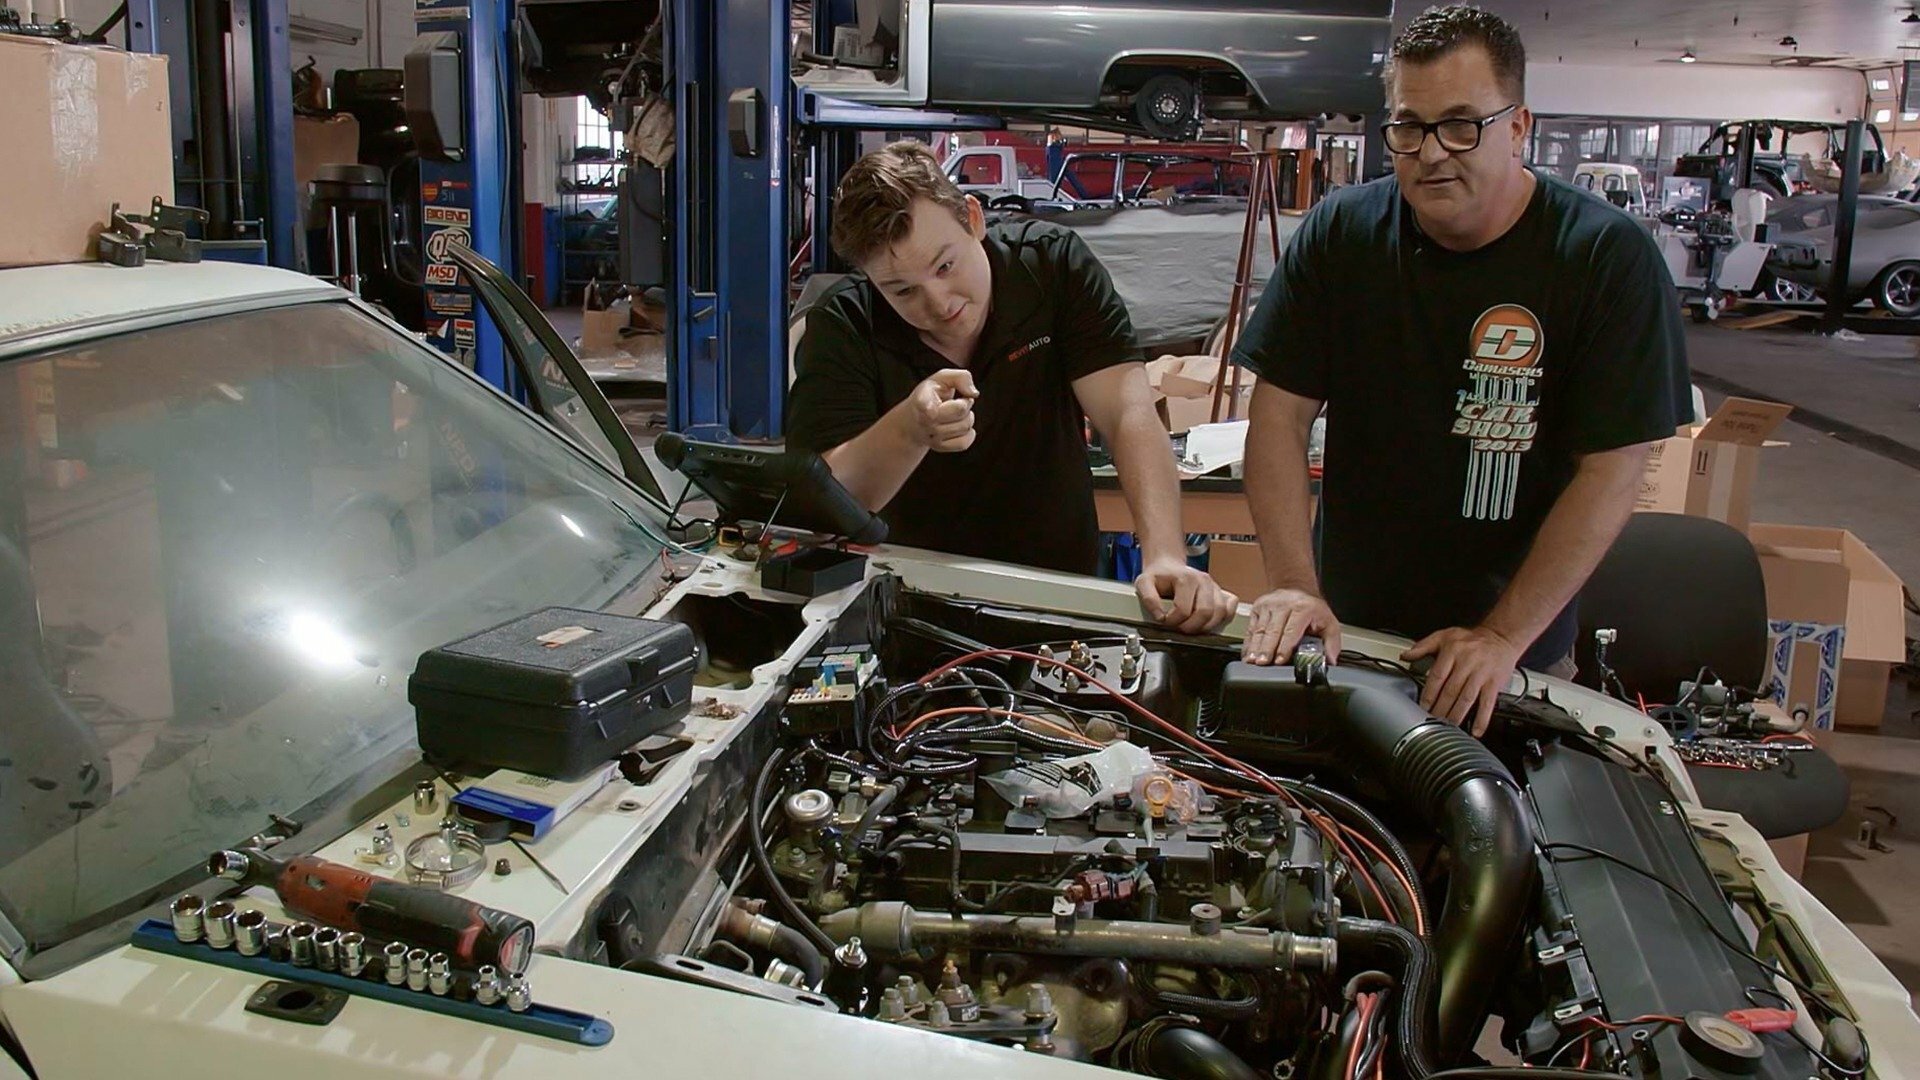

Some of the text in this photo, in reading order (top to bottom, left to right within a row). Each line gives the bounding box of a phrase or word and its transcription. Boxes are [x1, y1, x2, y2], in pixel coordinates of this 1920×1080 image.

[427, 266, 456, 278] MSD
[1462, 359, 1544, 378] Damascus
[1460, 403, 1535, 423] CAR
[1451, 417, 1538, 440] SHOW
[1474, 439, 1534, 452] 2013
